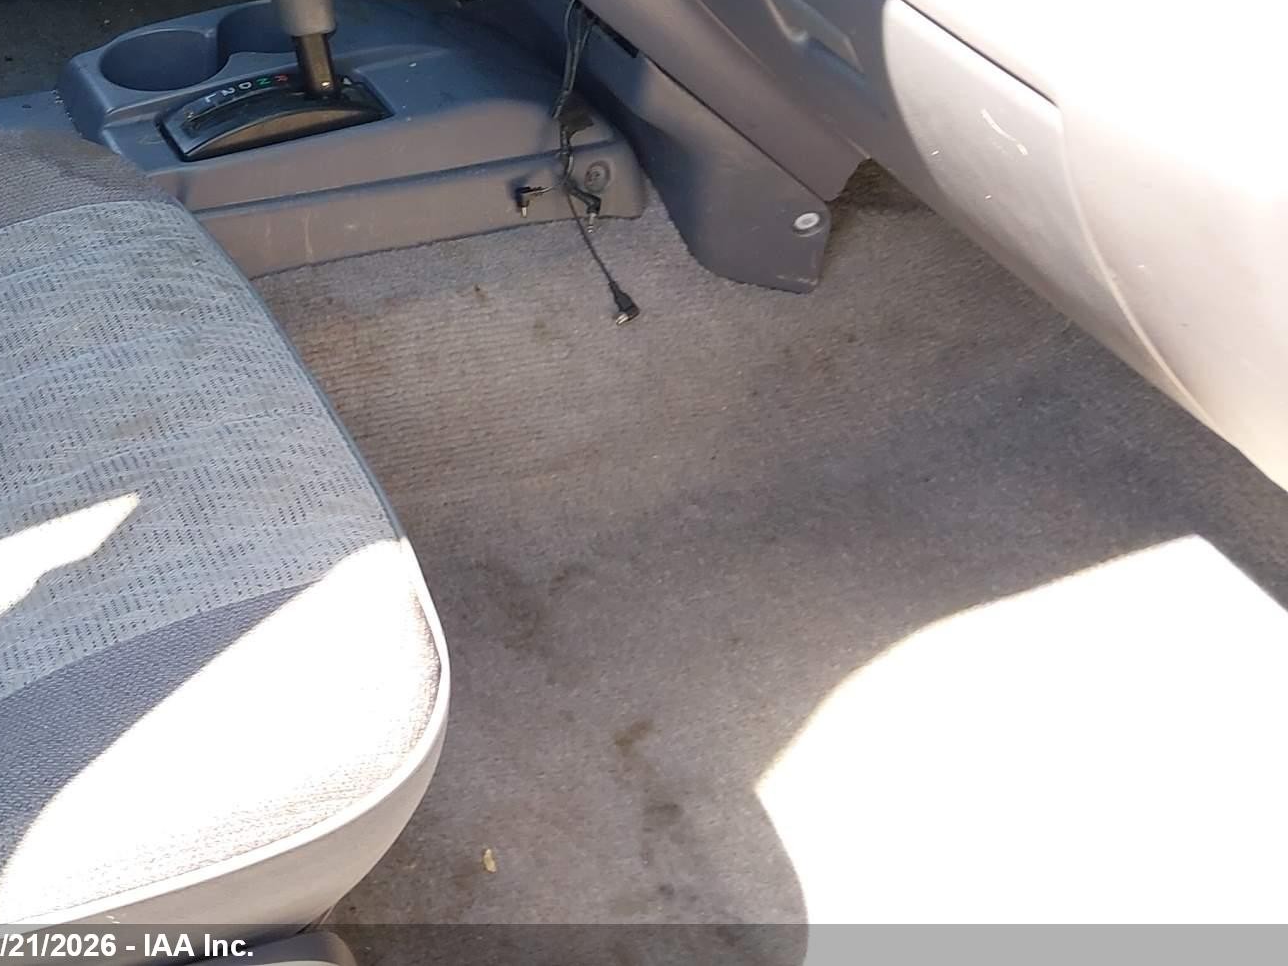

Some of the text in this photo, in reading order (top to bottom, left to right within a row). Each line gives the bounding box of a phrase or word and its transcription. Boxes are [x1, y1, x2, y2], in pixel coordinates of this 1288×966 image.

[239, 81, 252, 89] D
[256, 77, 271, 85] N
[221, 88, 235, 96] 2
